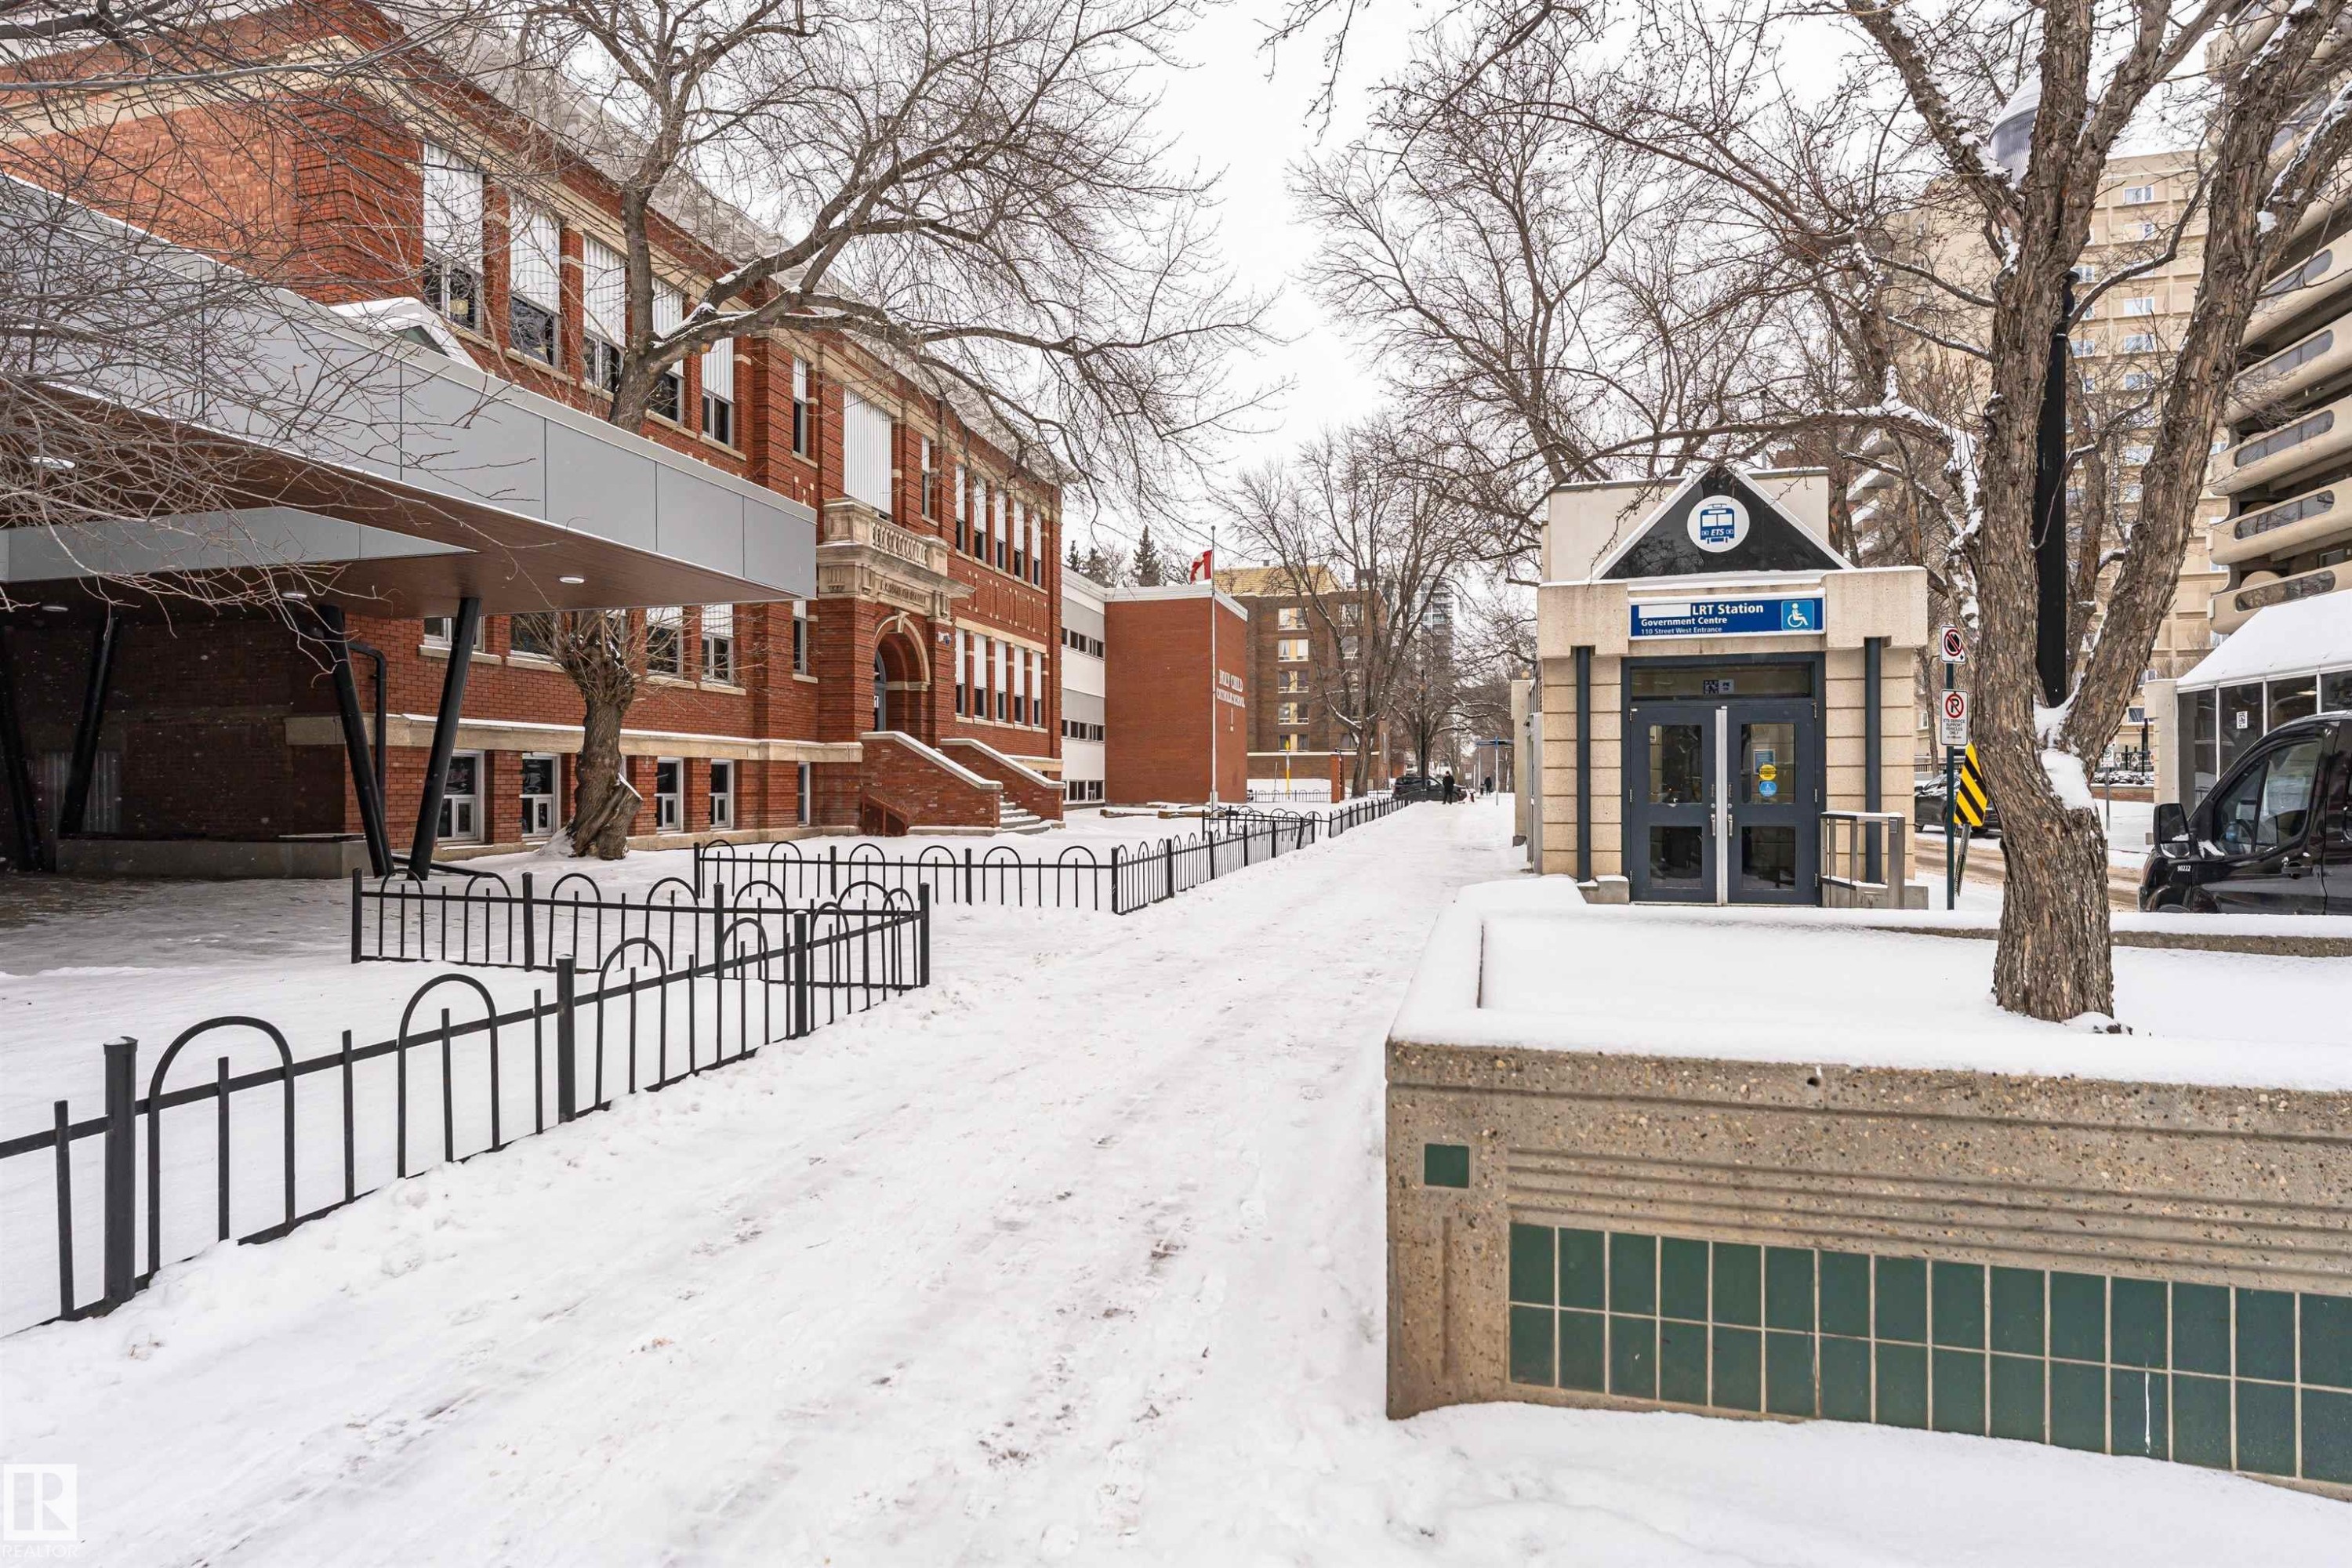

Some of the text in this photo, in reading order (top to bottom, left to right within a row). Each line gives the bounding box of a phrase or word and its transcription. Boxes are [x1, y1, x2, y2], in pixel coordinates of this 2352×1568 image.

[1692, 603, 1764, 615] LRT Station
[1641, 616, 1728, 626] Government Centre
